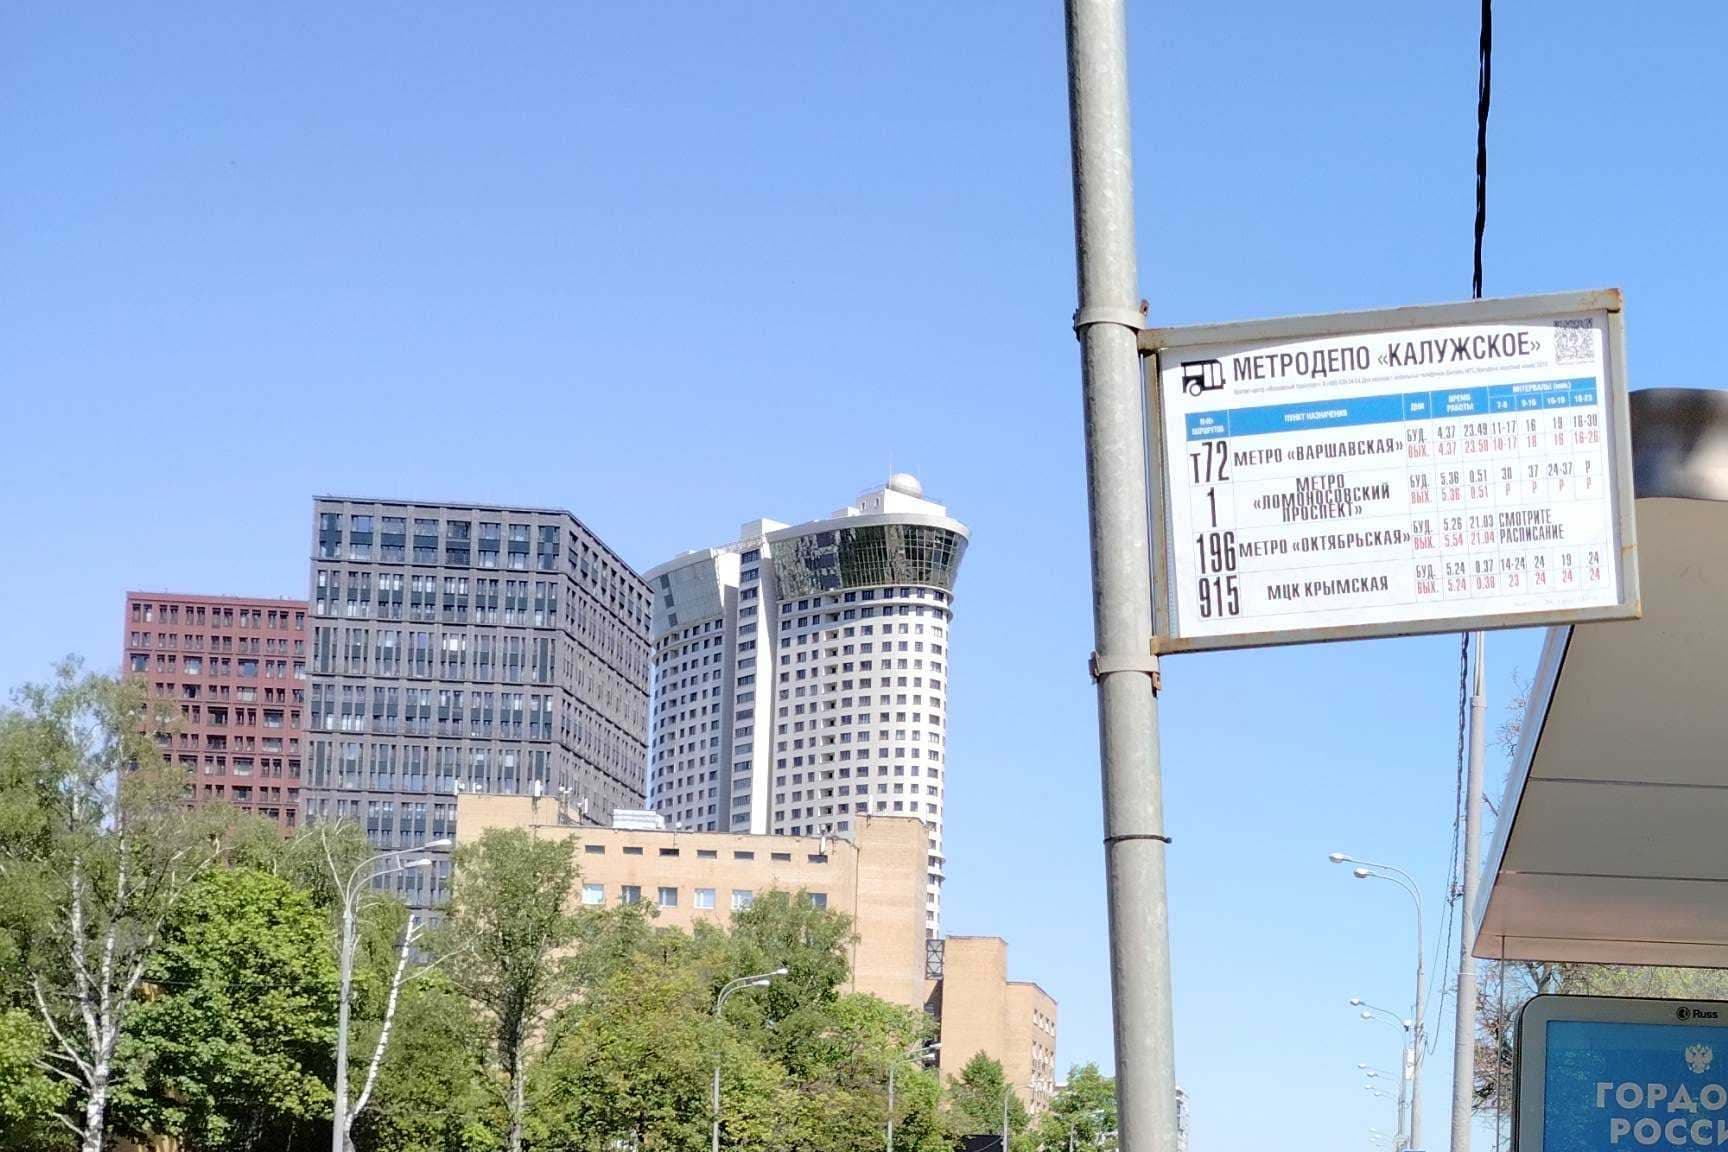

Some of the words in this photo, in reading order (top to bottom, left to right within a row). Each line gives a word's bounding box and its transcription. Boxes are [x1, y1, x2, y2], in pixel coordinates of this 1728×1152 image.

[1233, 346, 1370, 381] МЕТРОДЕПО
[1377, 332, 1541, 366] «КАЛУЖСКОЕ»
[1406, 428, 1428, 443] БУД.
[1234, 448, 1282, 467] МЕТРО
[1287, 437, 1403, 461] «ВАРШАВСКАЯ»
[1408, 443, 1430, 458] ВЫХ.
[1295, 473, 1345, 492] МЕТРО
[1410, 473, 1430, 489] БУД.
[1206, 487, 1217, 527] 1
[1252, 482, 1390, 510] «ЛОМОНОСОВСКИЙ
[1411, 488, 1433, 504] ВЫХ.
[1282, 498, 1363, 522] ПРОСПЕКТ»
[1412, 519, 1433, 535] БУД.
[1499, 508, 1552, 528] СМОТРИТЕ
[1239, 539, 1288, 557] МЕТРО
[1293, 529, 1411, 552] «ОКТЯБРЬСКАЯ»
[1414, 535, 1436, 550] ВЫХ.
[1500, 523, 1564, 544] РАСПИСАНИЕ
[1196, 531, 1237, 574] 196
[1416, 564, 1436, 580] БУД.
[1534, 555, 1545, 569] 24
[1588, 551, 1600, 565] 24
[1198, 575, 1240, 618] 915
[1266, 582, 1301, 601] МЦК
[1304, 575, 1389, 597] КРЫМСКАЯ
[1417, 580, 1439, 594] ВЫХ.
[1692, 1009, 1719, 1020] Russ
